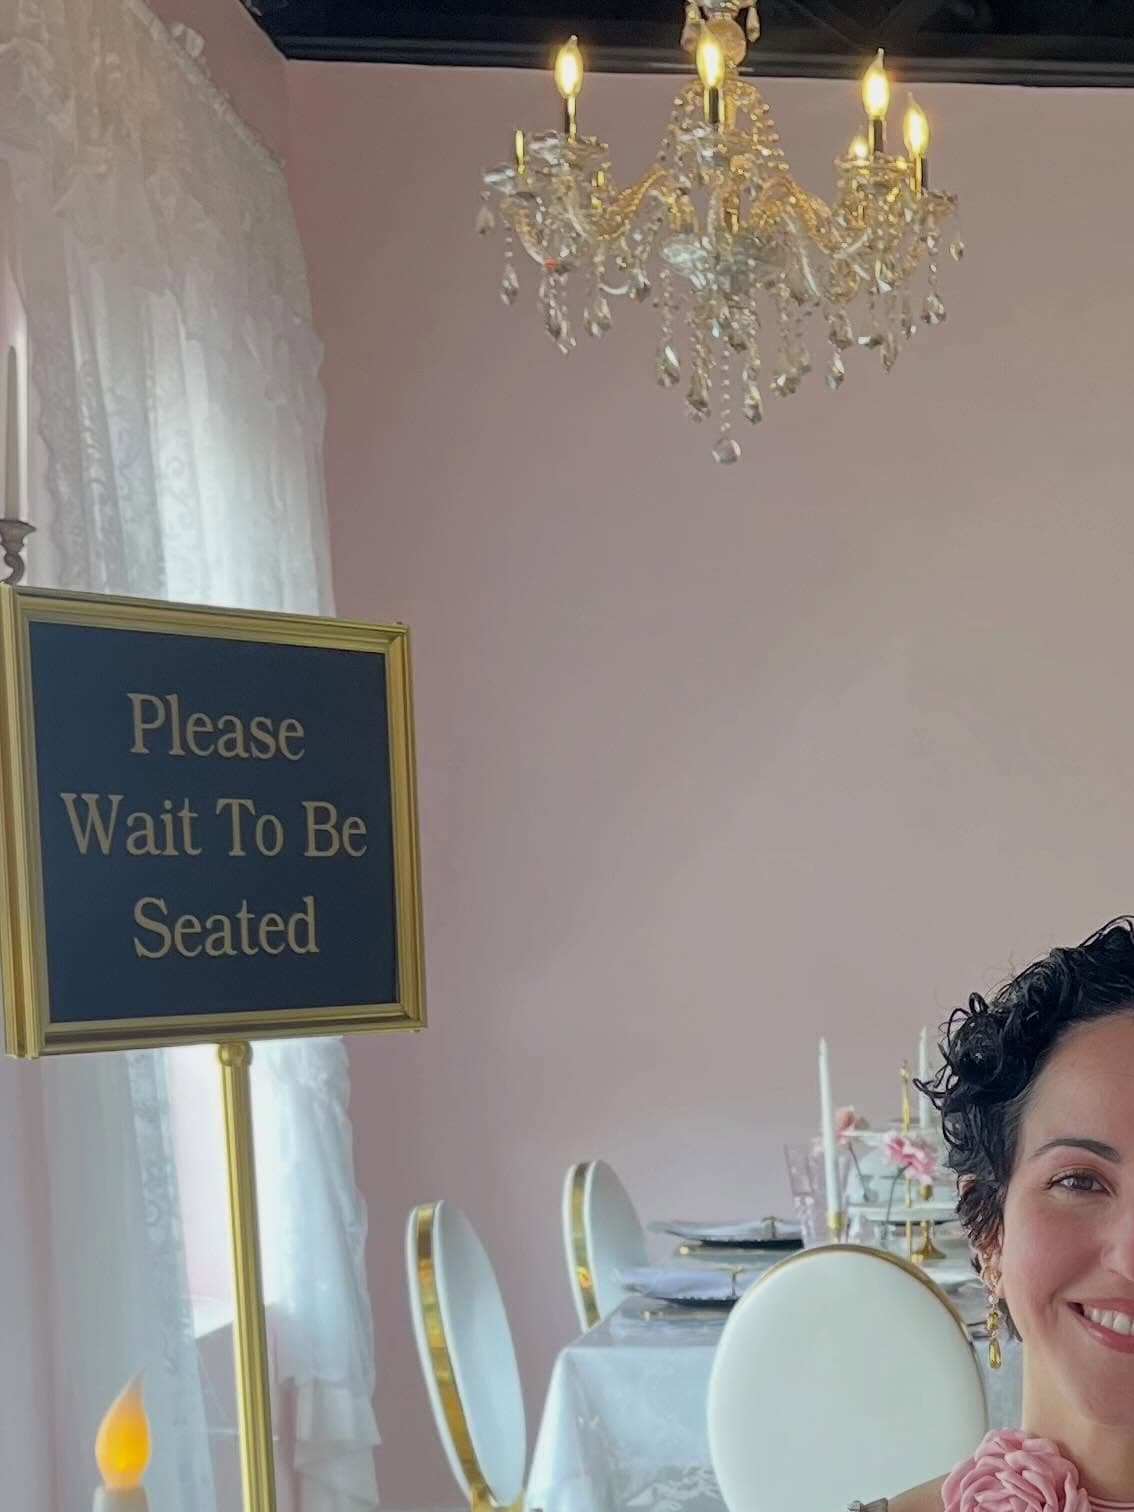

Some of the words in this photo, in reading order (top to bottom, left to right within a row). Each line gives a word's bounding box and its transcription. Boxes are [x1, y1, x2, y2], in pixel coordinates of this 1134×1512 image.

[127, 692, 305, 761] Please
[60, 792, 202, 856] Wait
[215, 798, 284, 857] To
[301, 800, 368, 857] Be
[133, 894, 320, 960] Seated
